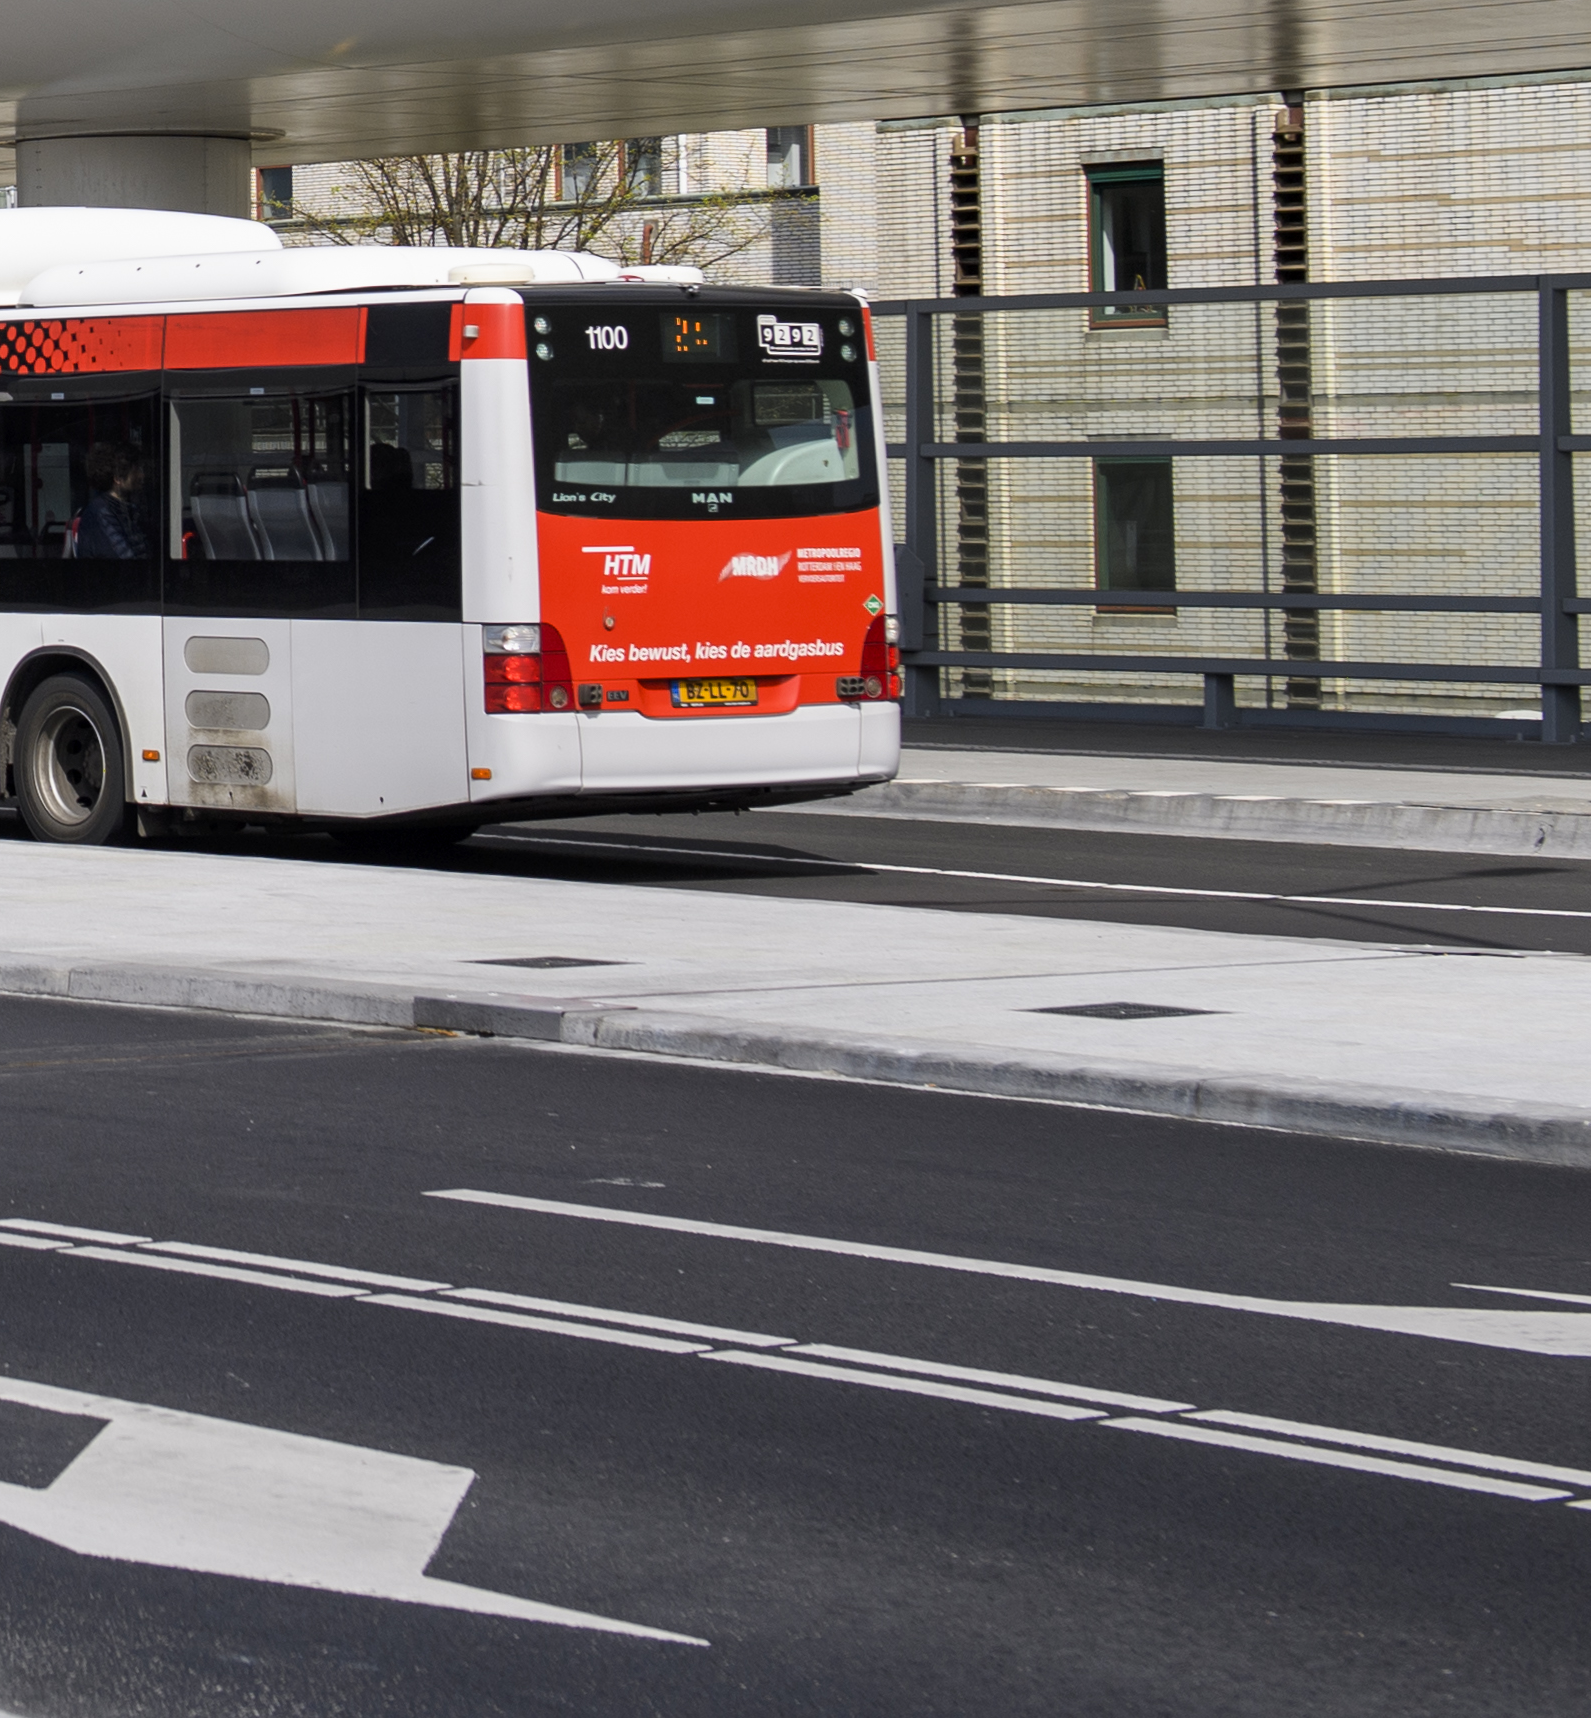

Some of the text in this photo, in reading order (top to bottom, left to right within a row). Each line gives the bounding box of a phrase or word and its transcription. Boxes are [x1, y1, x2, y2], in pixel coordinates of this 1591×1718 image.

[585, 326, 628, 350] 1100
[762, 327, 816, 343] 9292
[590, 491, 617, 504] City
[692, 492, 733, 504] MAN
[604, 553, 651, 576] HTM
[731, 555, 779, 577] MRDH
[589, 638, 844, 663] Kies bewust, kies de aardgasbus
[686, 681, 750, 699] BZ-LL-70
